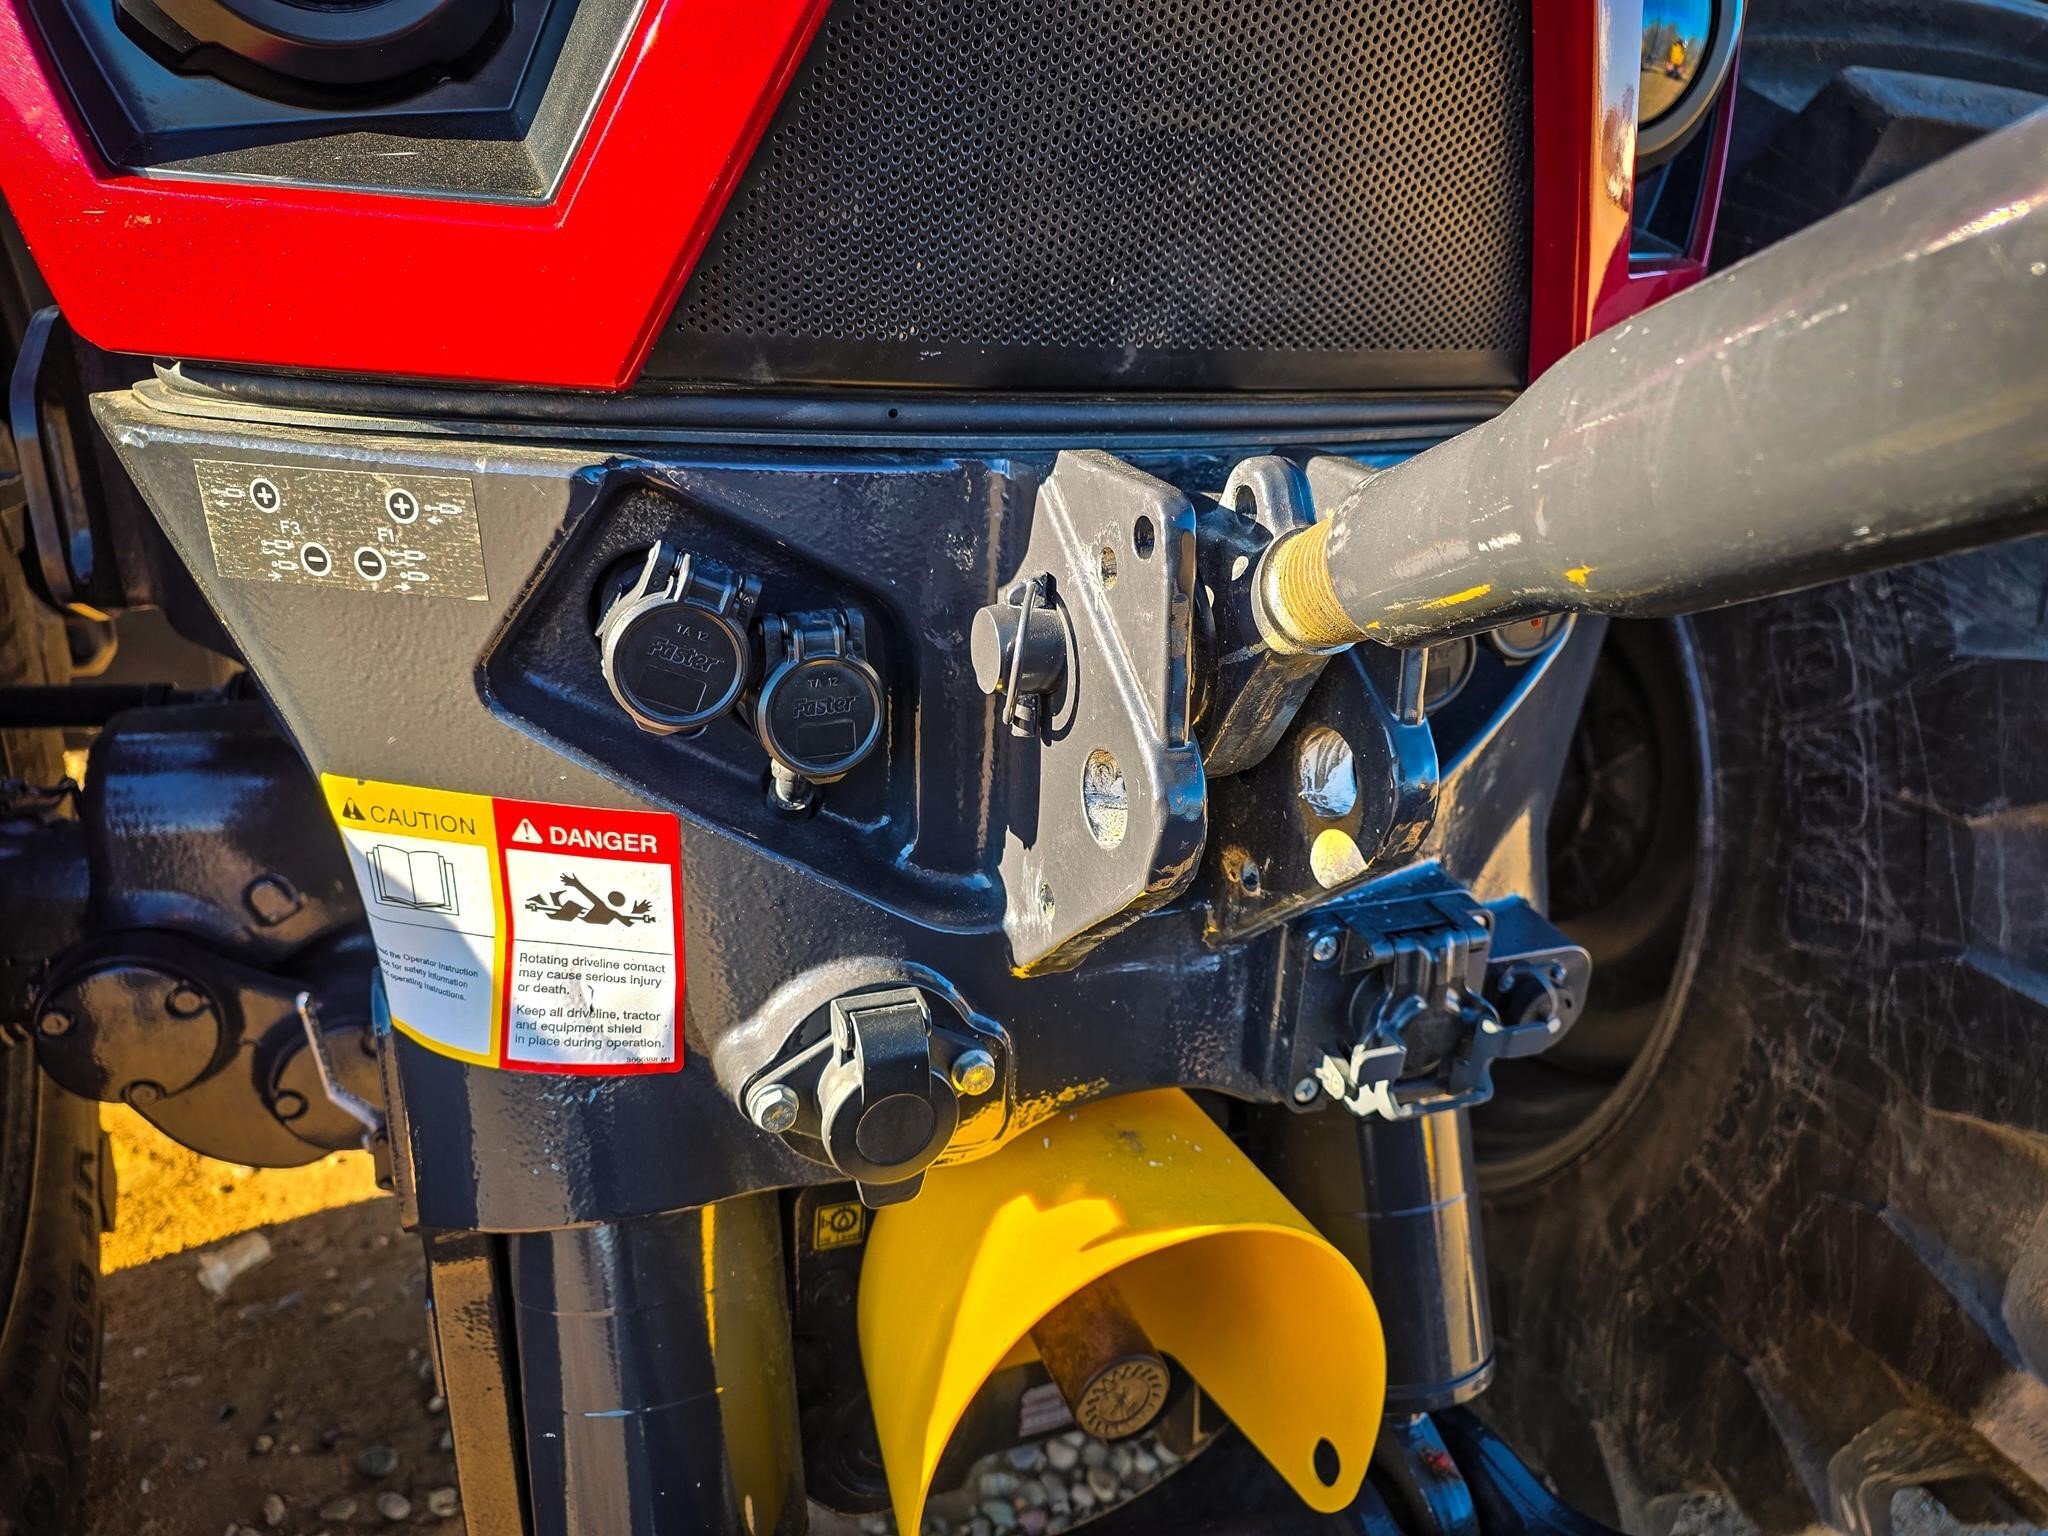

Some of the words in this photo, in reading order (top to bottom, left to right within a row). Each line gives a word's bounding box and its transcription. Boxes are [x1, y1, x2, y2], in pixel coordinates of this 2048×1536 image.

[279, 520, 301, 536] F3
[377, 527, 395, 543] F1
[676, 623, 690, 637] TA
[697, 630, 709, 641] 12
[647, 639, 720, 673] Faster
[808, 679, 822, 688] TA
[828, 677, 839, 687] 12
[793, 695, 857, 719] Faster
[370, 805, 476, 836] CAUTION
[549, 826, 658, 854] DANGER
[403, 953, 437, 968] Operator
[519, 952, 568, 968] Rotating
[572, 956, 620, 970] driveline
[623, 962, 666, 974] contact
[518, 968, 543, 980] may
[546, 970, 582, 981] cause
[585, 973, 627, 984] serious
[630, 974, 662, 988] injury
[517, 983, 530, 992] or
[533, 983, 570, 995] death.
[516, 1004, 546, 1018] Keep
[549, 1007, 563, 1018] all
[567, 1007, 620, 1021] driveline,
[623, 1010, 661, 1021] tractor
[515, 1020, 537, 1031] and
[540, 1022, 604, 1035] equipment
[607, 1024, 642, 1035] shield
[515, 1034, 525, 1044] in
[528, 1034, 561, 1048] place
[564, 1036, 603, 1050] during
[606, 1037, 665, 1051] operation.
